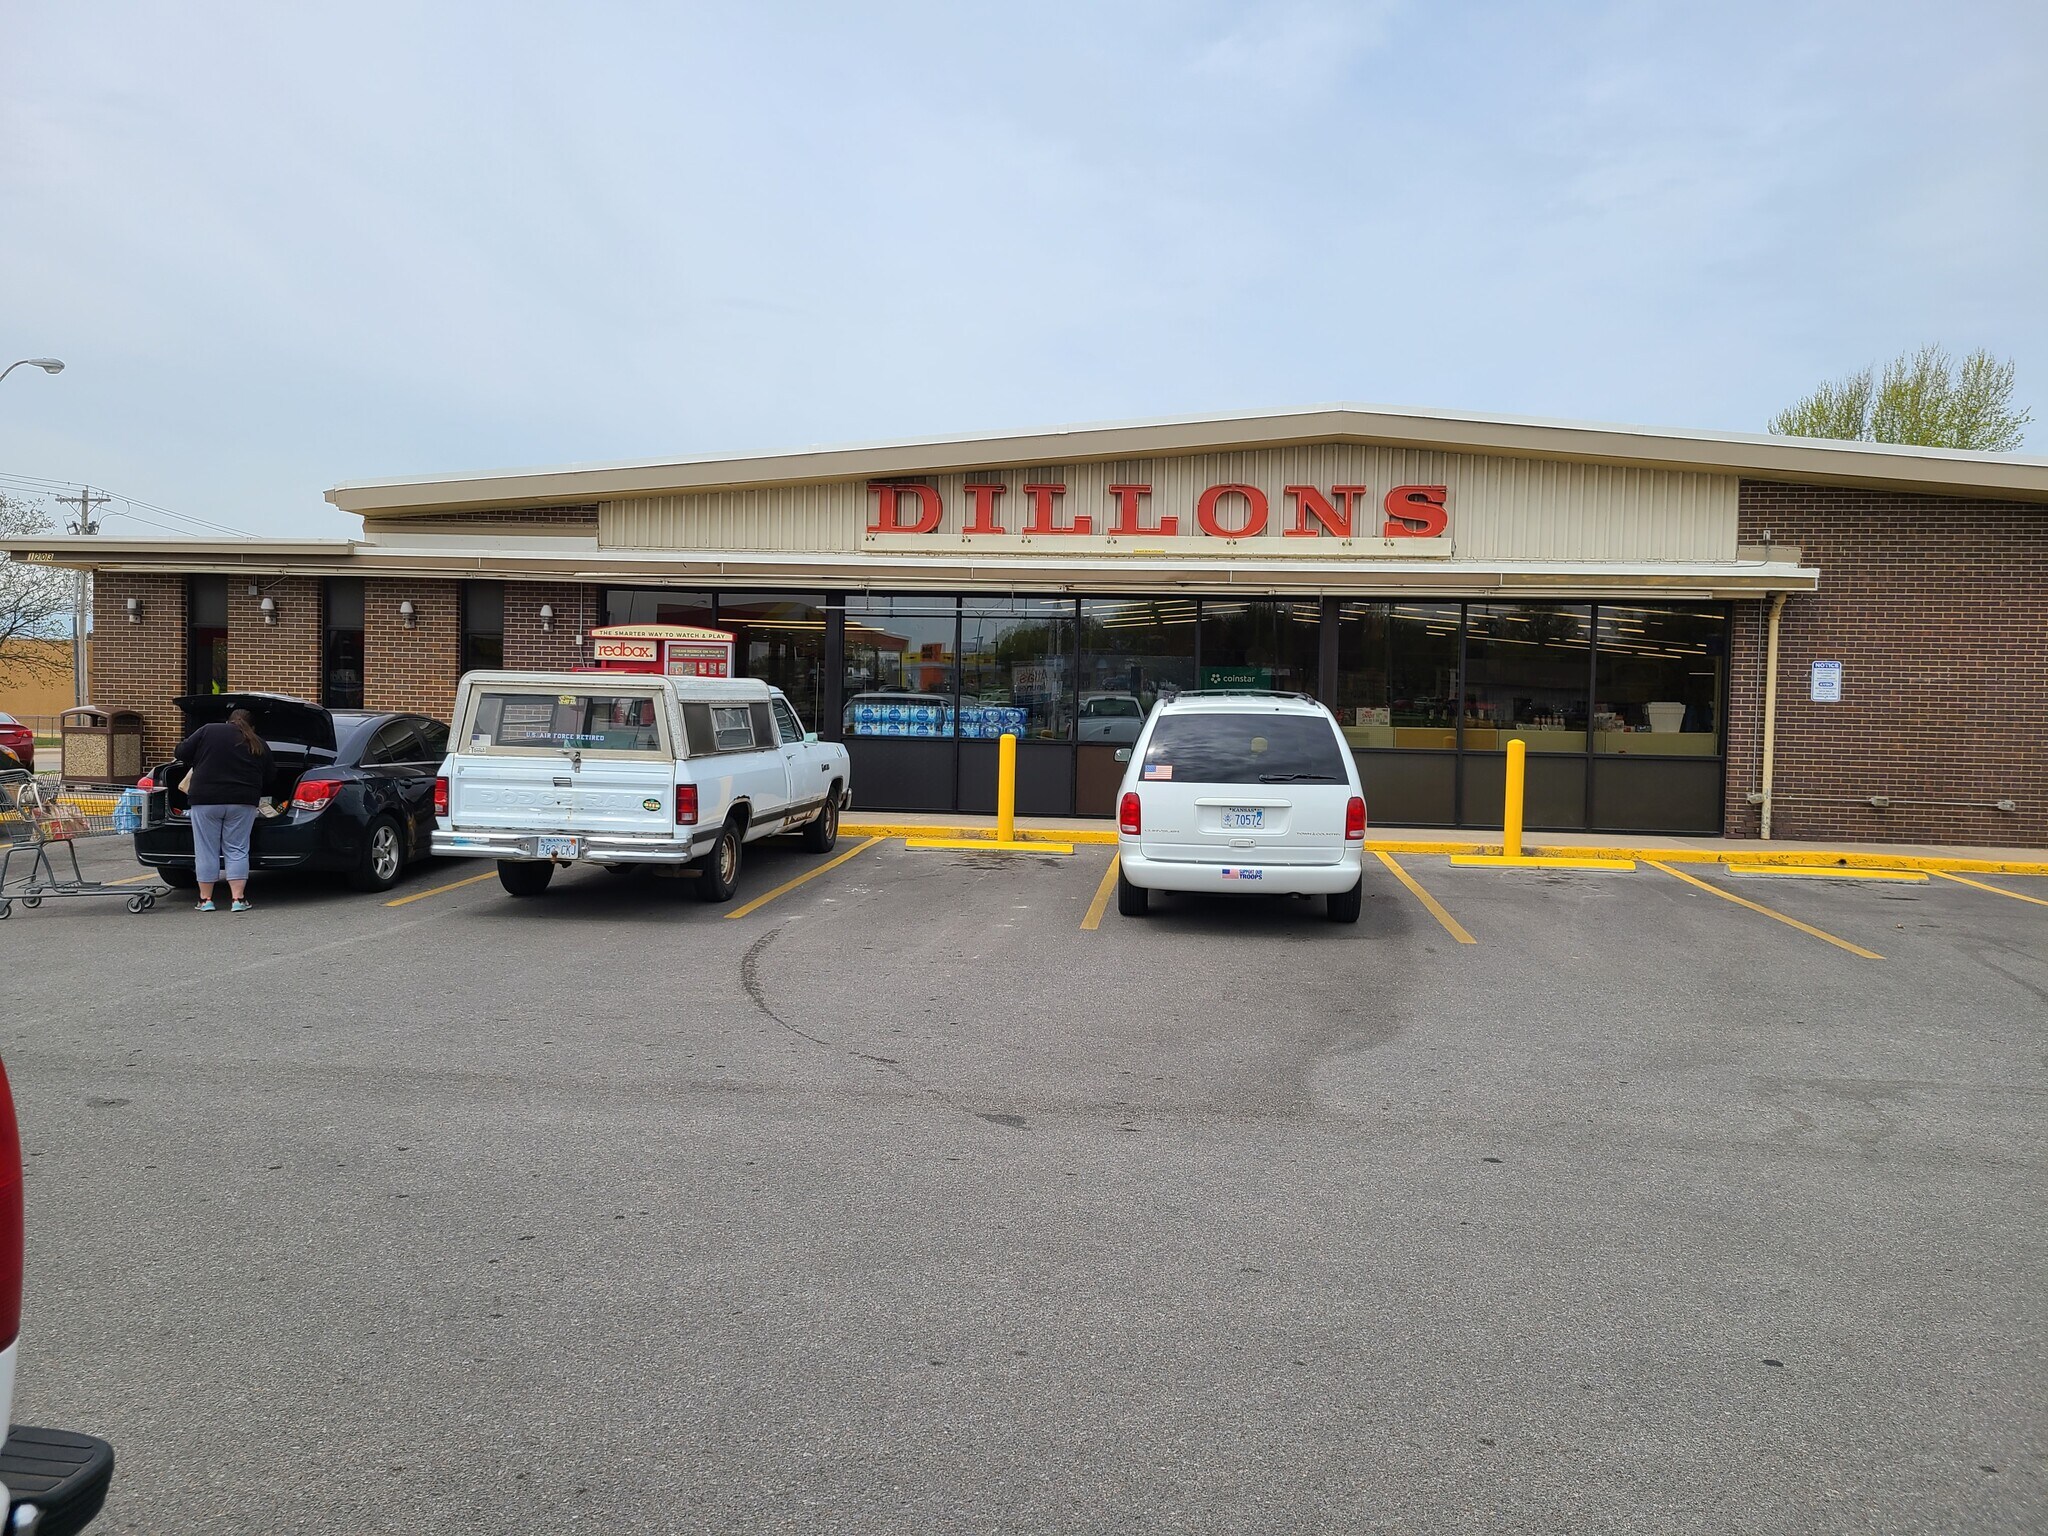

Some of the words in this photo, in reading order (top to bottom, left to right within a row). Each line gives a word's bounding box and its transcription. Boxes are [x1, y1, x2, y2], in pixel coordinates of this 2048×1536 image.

[866, 483, 1449, 538] DILLONS
[27, 552, 54, 561] 1203
[481, 790, 573, 806] DODGE
[585, 793, 645, 808] RAM
[1235, 814, 1262, 825] 70572
